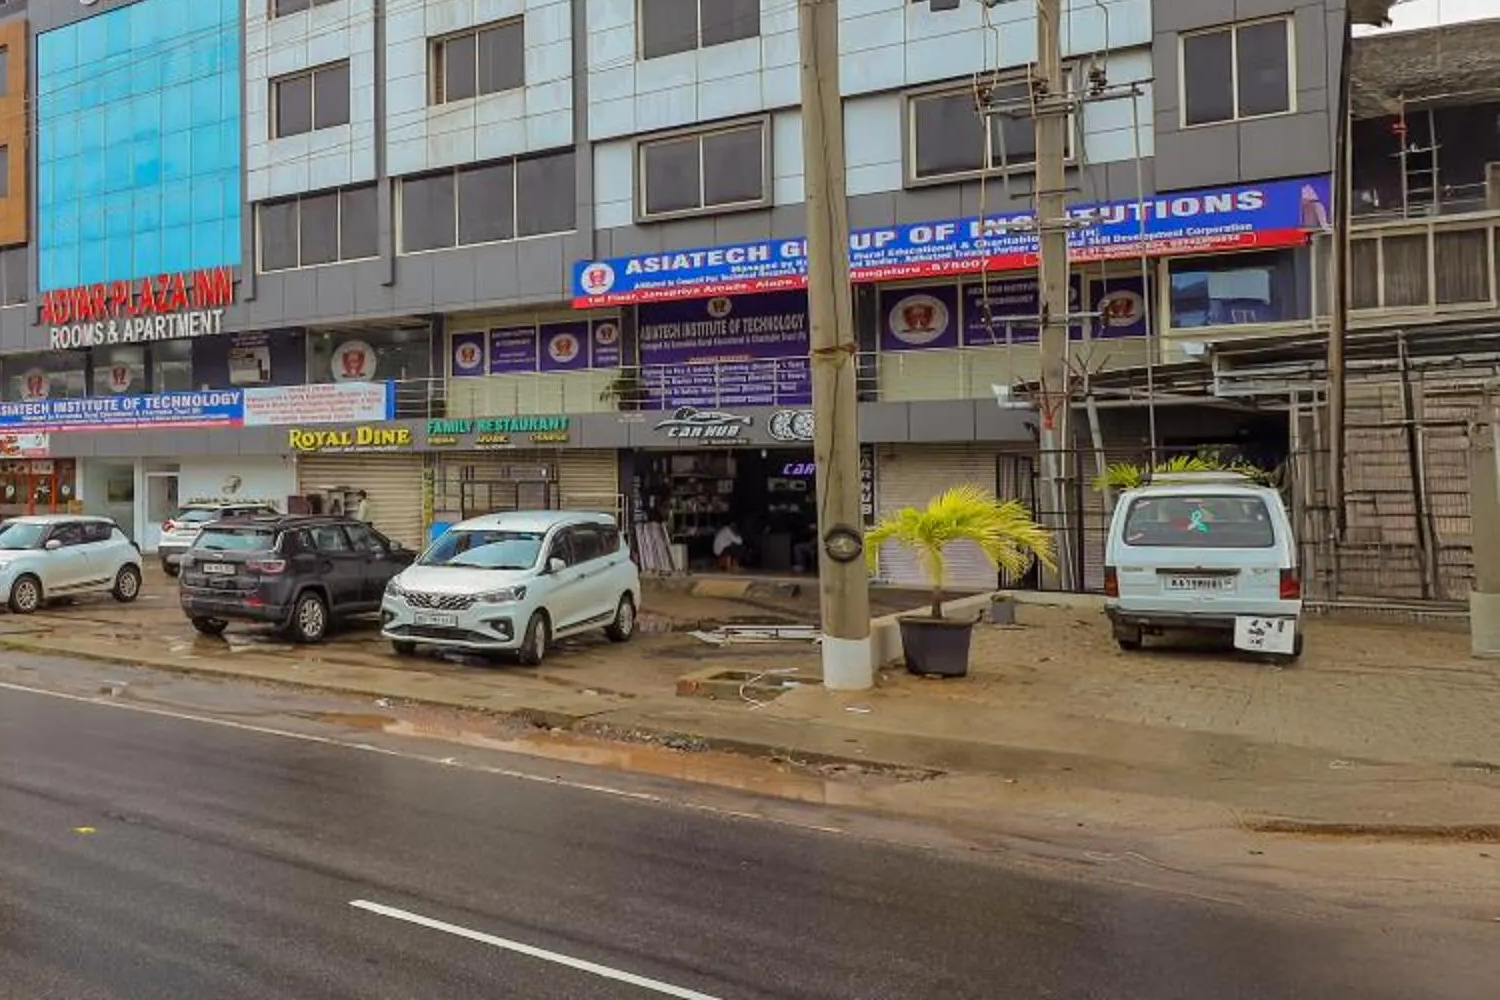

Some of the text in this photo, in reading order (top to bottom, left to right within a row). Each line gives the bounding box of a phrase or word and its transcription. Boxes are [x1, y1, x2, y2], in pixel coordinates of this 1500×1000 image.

[625, 244, 768, 275] ASIATECH
[780, 231, 895, 259] GUP
[908, 223, 955, 244] OF
[110, 272, 189, 317] PLAZA
[192, 265, 233, 307] INN
[50, 308, 223, 350] ROOMS & APARTMENT
[681, 318, 727, 338] INSTITUTE
[728, 317, 741, 335] OF
[742, 313, 805, 333] TECHNOLOGY
[53, 399, 119, 414] INSTITUTE
[123, 396, 141, 410] OF
[144, 391, 241, 409] TECHNOLOGY
[427, 415, 569, 434] FAMILY RESTAURANT
[668, 425, 740, 437] CAR HUB
[289, 425, 411, 451] ROYAL DINE
